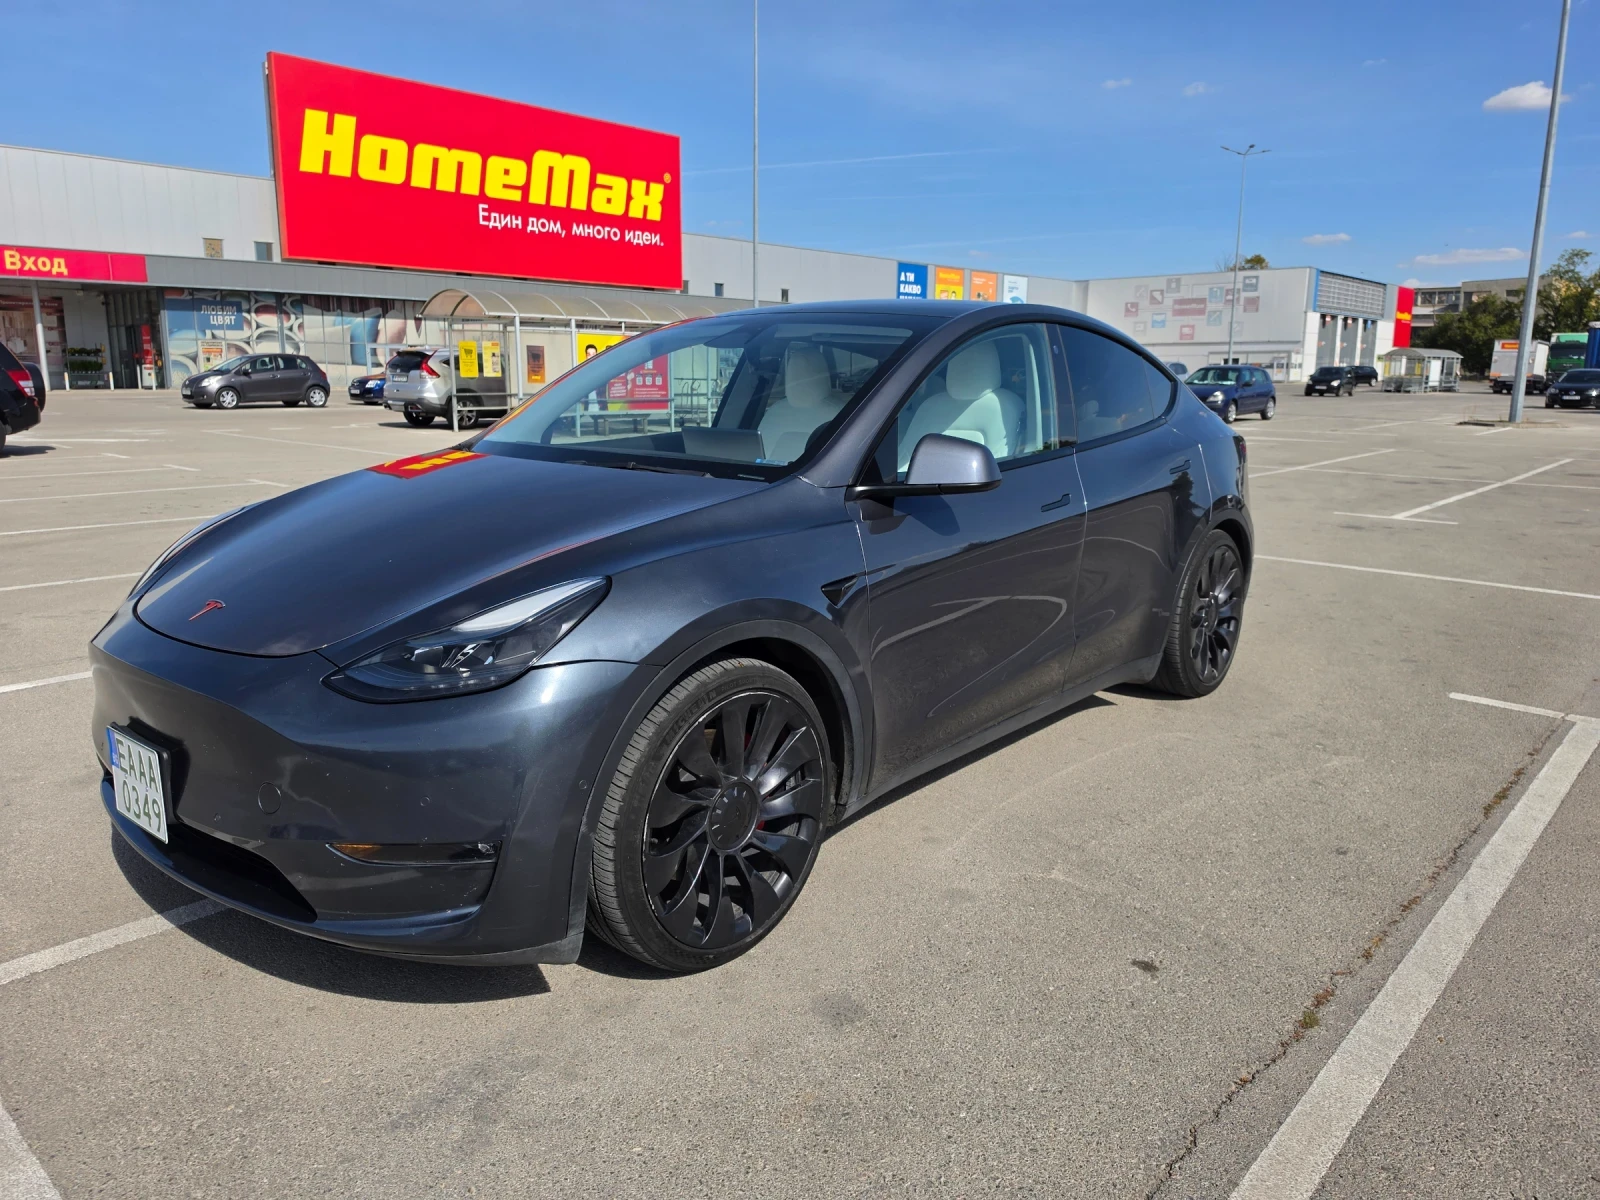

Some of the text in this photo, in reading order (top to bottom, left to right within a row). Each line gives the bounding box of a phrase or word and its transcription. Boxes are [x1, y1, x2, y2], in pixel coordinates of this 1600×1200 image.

[299, 108, 664, 221] HomeMax
[478, 203, 664, 246] Един дом, много идеи.
[4, 249, 69, 276] Вход
[899, 283, 922, 295] КАКВО
[201, 305, 237, 315] ЛЮБИМ
[210, 315, 236, 326] ЦВЯТ
[122, 780, 161, 833] 0349
